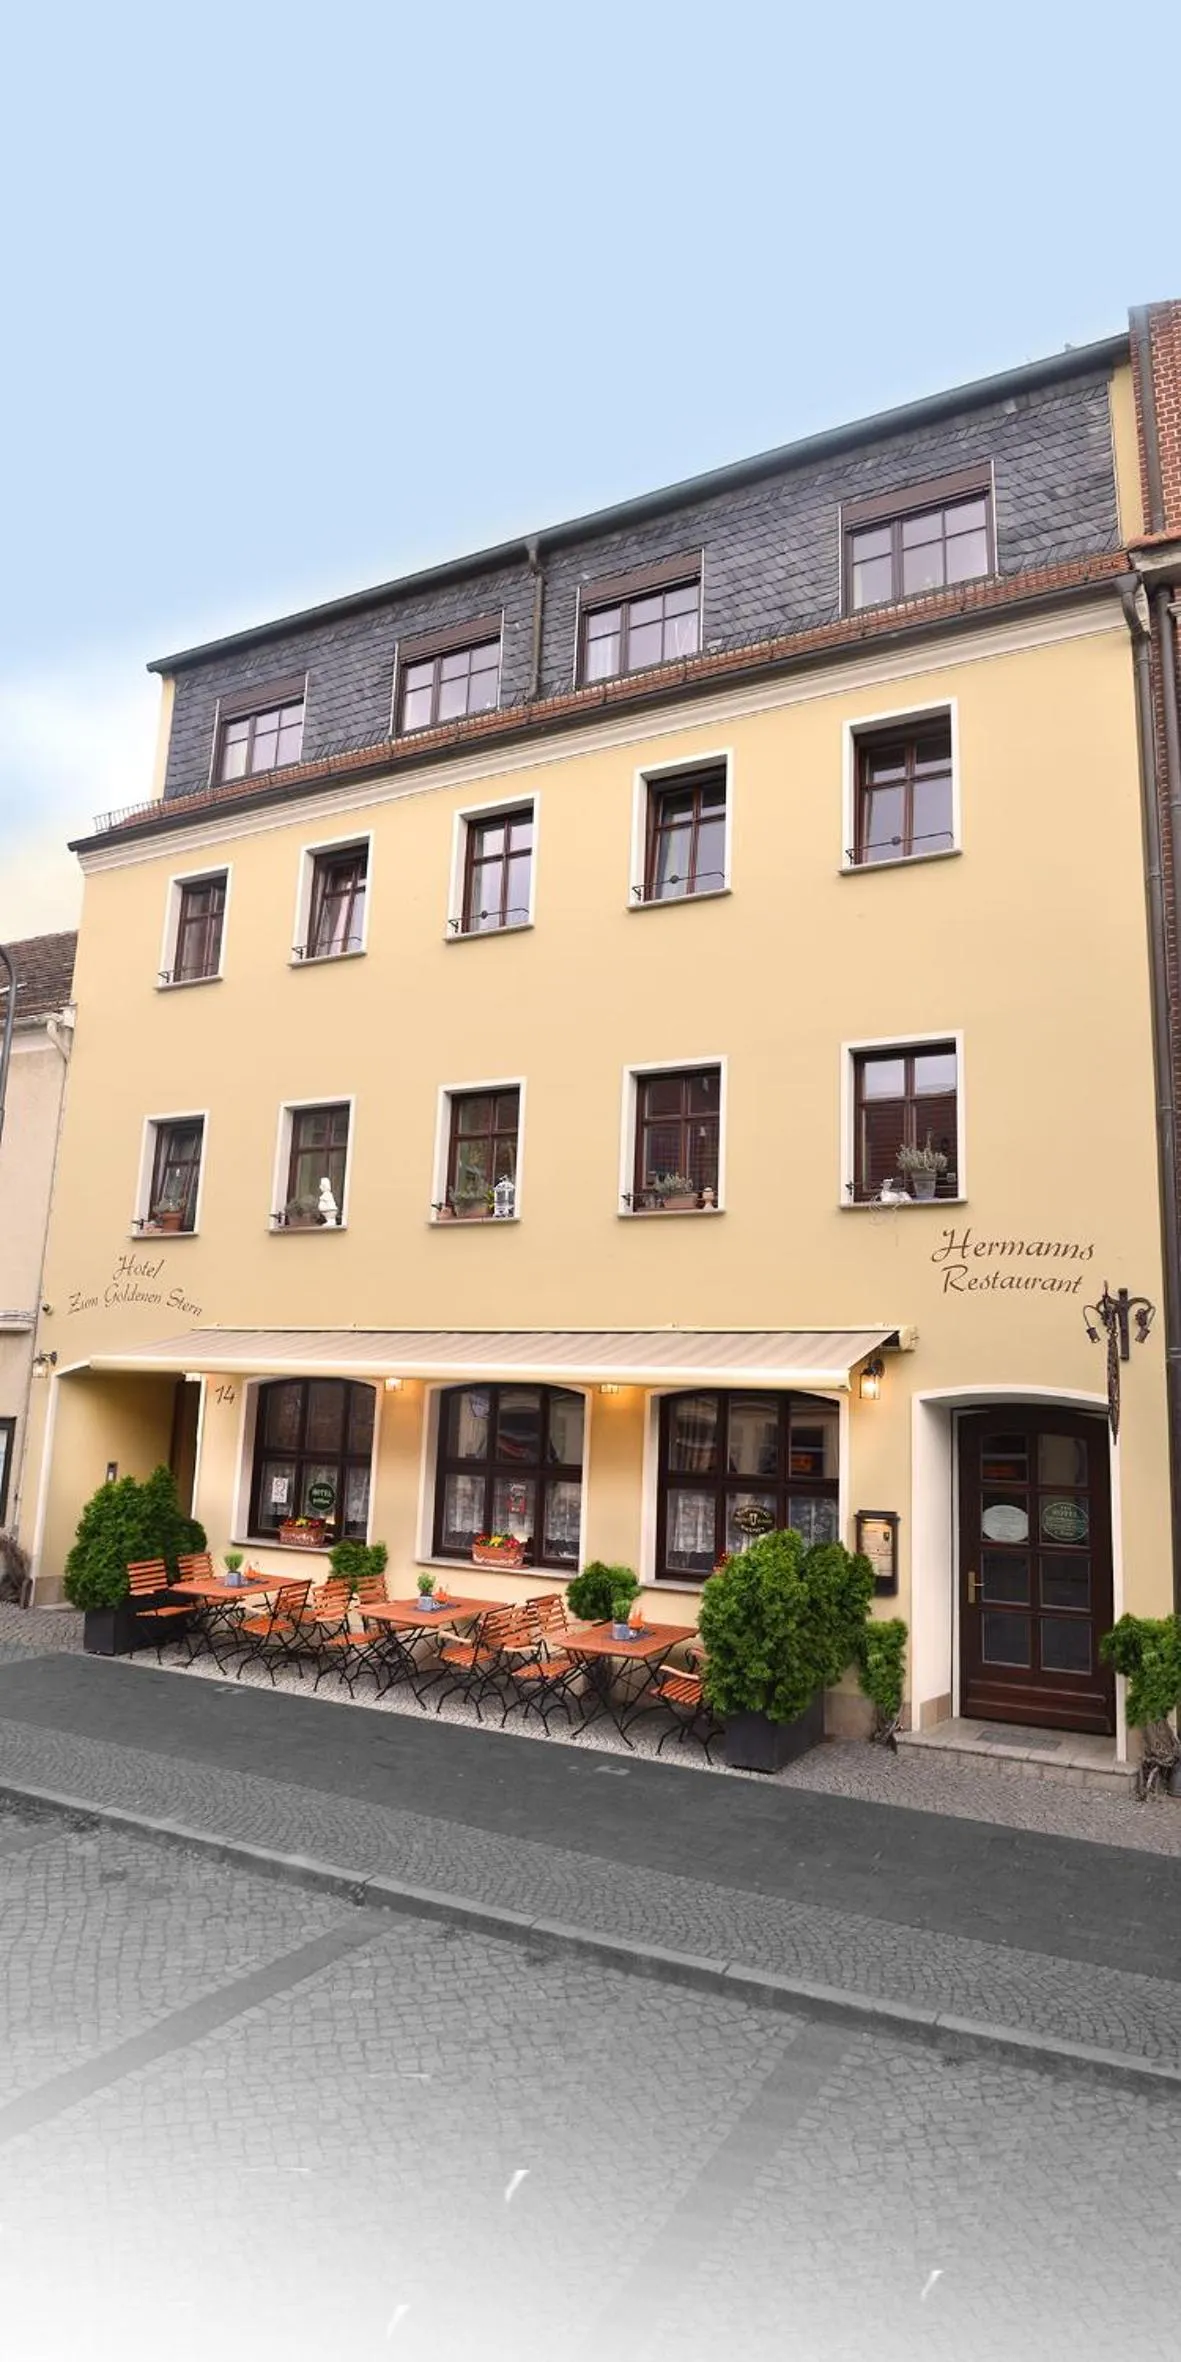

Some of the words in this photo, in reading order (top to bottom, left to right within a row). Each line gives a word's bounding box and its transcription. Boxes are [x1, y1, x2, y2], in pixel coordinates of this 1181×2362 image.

[931, 1228, 1095, 1262] Hermanns
[112, 1254, 165, 1281] Hotel
[941, 1264, 1084, 1293] Restaurant
[67, 1291, 99, 1315] Zum
[104, 1282, 162, 1308] Goldenen
[166, 1288, 202, 1317] Stern
[215, 1384, 235, 1404] 14
